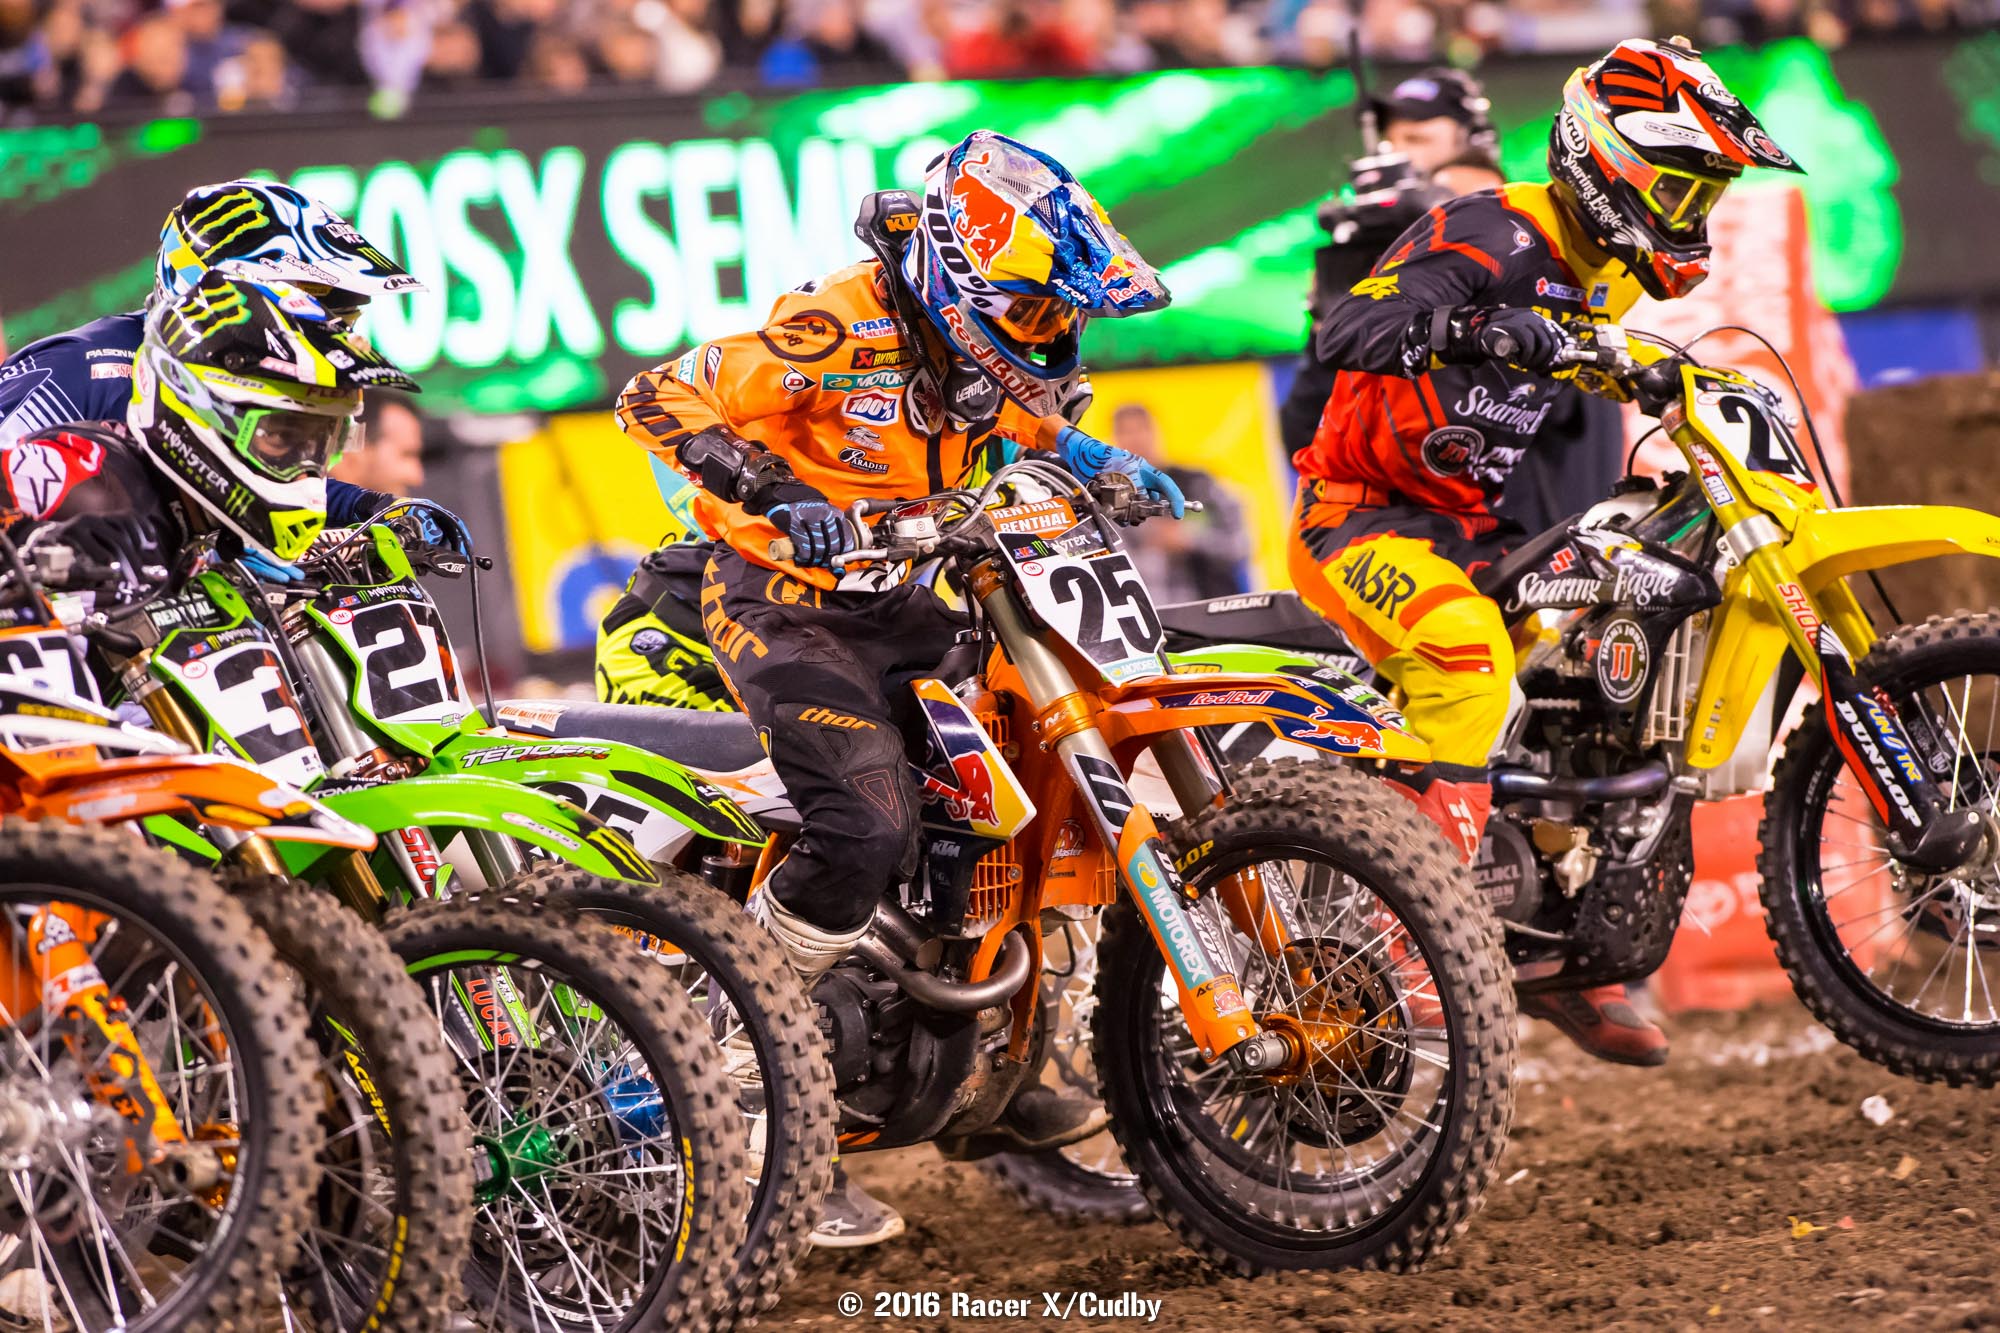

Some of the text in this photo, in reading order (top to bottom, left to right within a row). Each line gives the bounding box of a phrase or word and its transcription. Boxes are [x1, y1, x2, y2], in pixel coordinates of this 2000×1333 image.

[1561, 152, 1623, 229] Soaring Eagle
[926, 186, 1003, 310] 100%
[1052, 278, 1089, 305] Airoh
[940, 304, 1047, 404] Red Bull
[849, 396, 896, 420] 100%
[158, 418, 230, 495] MONSTER
[991, 499, 1065, 519] RENTHAL
[1703, 474, 1734, 507] AIR
[1000, 511, 1072, 533] RENTHAL
[1207, 596, 1272, 614] SUZUKI
[1612, 564, 1681, 606] Eagle
[1049, 553, 1164, 665] 25
[213, 648, 316, 765] 3
[797, 707, 877, 731] thor
[1188, 690, 1275, 706] Red Bull
[461, 743, 612, 769] TEDDER
[1834, 699, 1923, 828] DUNLOP
[313, 781, 379, 800] TOMAC
[400, 827, 442, 897] SHO
[930, 839, 961, 858] KTM
[1149, 886, 1209, 984] MOTOREX
[464, 978, 519, 1048] LUCAS
[676, 1136, 695, 1264] DUNLOP
